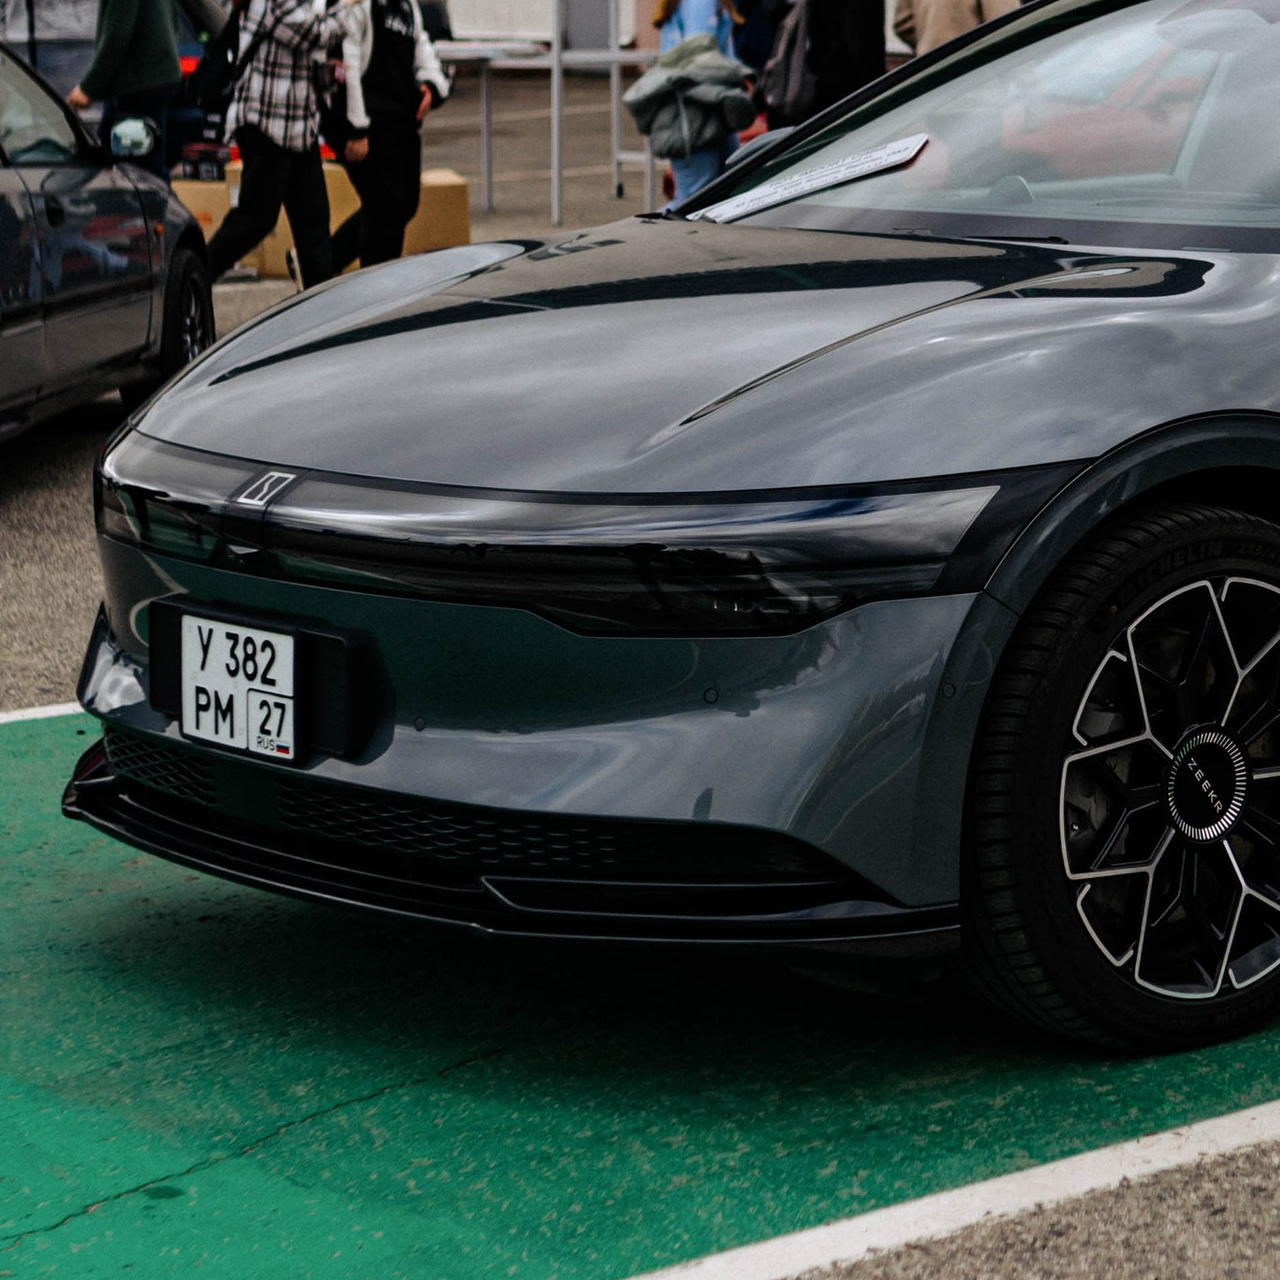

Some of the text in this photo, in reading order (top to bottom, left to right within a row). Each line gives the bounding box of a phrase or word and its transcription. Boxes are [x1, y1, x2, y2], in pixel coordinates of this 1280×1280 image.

[1118, 540, 1224, 606] MICHELIN
[225, 631, 277, 687] 382
[256, 736, 276, 752] RUS
[259, 699, 286, 738] 27
[1187, 757, 1223, 814] ZEEKR
